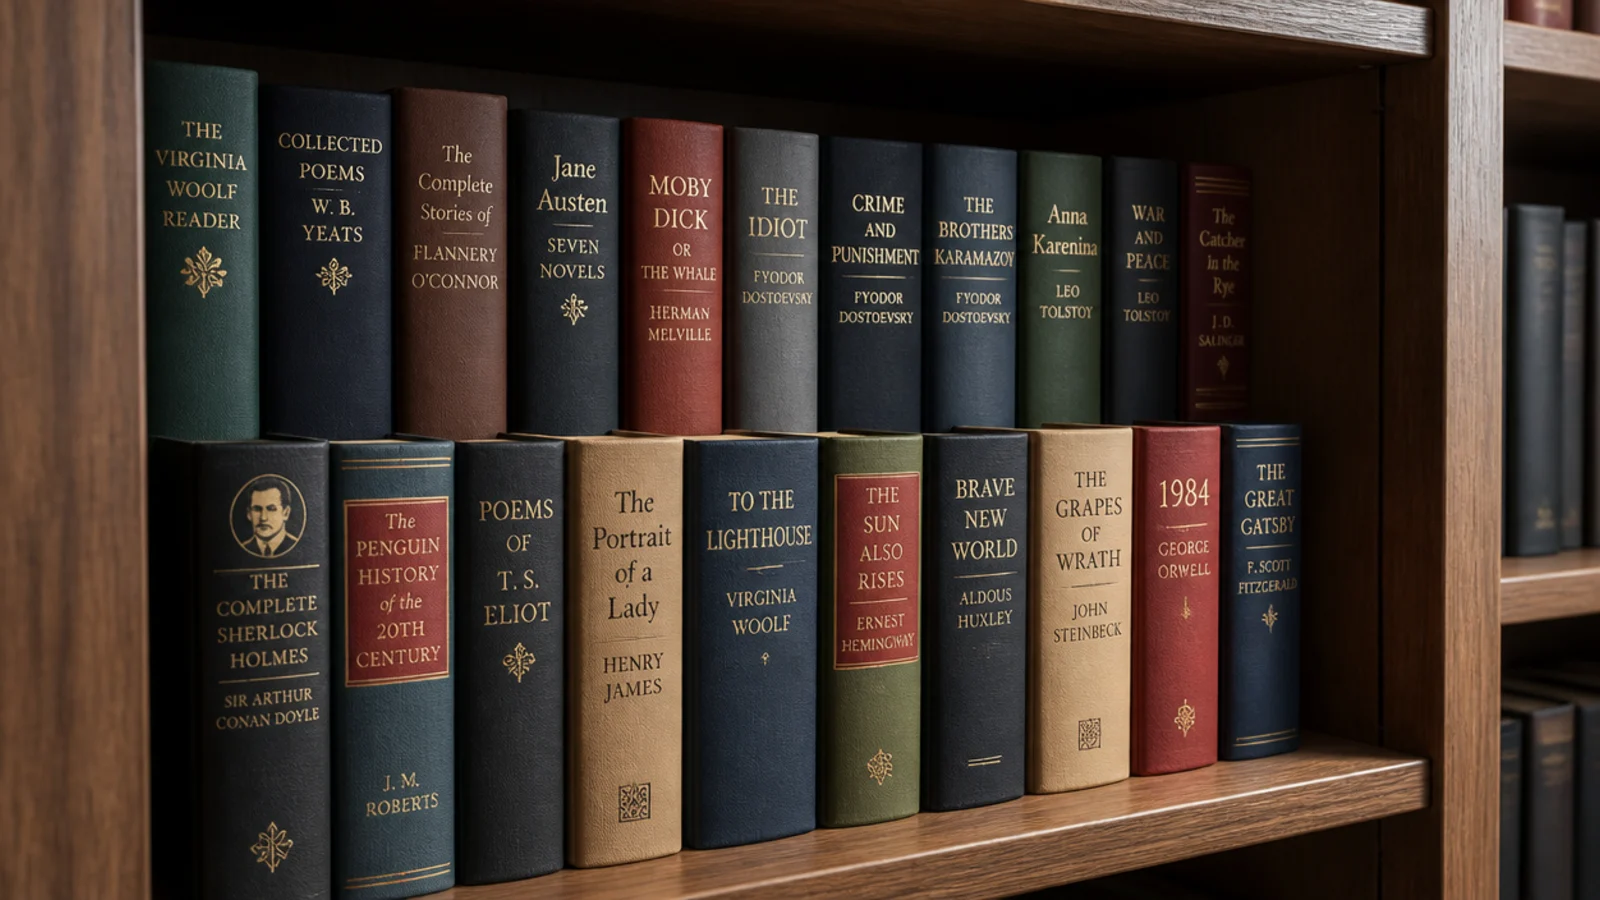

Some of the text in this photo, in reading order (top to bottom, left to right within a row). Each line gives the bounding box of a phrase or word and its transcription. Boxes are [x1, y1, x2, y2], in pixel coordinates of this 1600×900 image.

[180, 121, 222, 140] THE
[278, 132, 383, 154] COLLECTED
[155, 150, 247, 171] VIRGINIA
[442, 145, 472, 164] The
[299, 163, 365, 182] POEMS
[552, 155, 596, 182] Jane
[166, 180, 238, 199] WOOLF
[418, 173, 493, 197] Complete
[649, 174, 712, 198] MOBY
[537, 189, 608, 213] Austen
[761, 187, 799, 206] THE
[852, 194, 905, 214] CRIME
[964, 196, 994, 214] THE
[312, 199, 355, 216] W. B.
[420, 203, 493, 227] Stories of
[1047, 204, 1088, 226] Anna
[1132, 204, 1166, 222] WAR
[1213, 207, 1235, 226] The
[163, 210, 241, 230] READER
[653, 208, 708, 230] DICK
[748, 216, 808, 240] IDIOT
[302, 225, 363, 243] YEATS
[865, 222, 896, 238] AND
[939, 221, 1014, 241] BROTHERS
[1134, 230, 1163, 244] AND
[1199, 230, 1246, 248] Catcher
[413, 244, 498, 263] FLANNERY
[547, 238, 599, 255] SEVEN
[673, 242, 691, 258] OR
[1032, 234, 1098, 257] Karenina
[832, 246, 919, 266] PUNISHMENT
[1126, 252, 1170, 270] PEACE
[1207, 255, 1240, 271] in the
[540, 263, 605, 280] NOVELS
[641, 265, 717, 282] THE WHALE
[412, 273, 499, 290] O'CONNOR
[1056, 284, 1080, 298] LEO
[1213, 276, 1235, 298] Rye
[1137, 292, 1160, 304] LEO
[649, 305, 710, 321] HERMAN
[1040, 305, 1093, 319] TOLSTOY
[1123, 308, 1171, 322] TOLSTOY
[648, 327, 711, 342] MELVILLE
[1074, 471, 1107, 488] THE
[1257, 463, 1286, 481] THE
[866, 487, 899, 504] THE
[956, 477, 1015, 499] BRAVE
[1159, 478, 1210, 508] 1984
[615, 490, 654, 514] The
[728, 489, 794, 512] TO THE
[1056, 497, 1122, 518] GRAPES
[1244, 489, 1295, 508] GREAT
[479, 499, 554, 521] POEMS
[964, 508, 1007, 528] NEW
[385, 513, 416, 530] The
[864, 515, 900, 533] SUN
[1240, 516, 1295, 535] GATSBY
[506, 534, 531, 552] OF
[593, 524, 672, 550] Portrait
[706, 525, 812, 550] LIGHTHOUSE
[1081, 526, 1101, 542] OF
[356, 537, 440, 558] PENGUIN
[859, 543, 903, 562] ALSO
[952, 538, 1018, 560] WORLD
[1056, 549, 1121, 570] WRATH
[357, 565, 440, 585] HISTORY
[497, 569, 539, 591] T. S.
[615, 560, 652, 588] of a
[858, 571, 904, 590] RISES
[1158, 563, 1211, 579] ORWELL
[249, 572, 288, 590] THE
[216, 595, 318, 617] COMPLETE
[380, 592, 423, 615] of the
[726, 588, 797, 607] VIRGINIA
[959, 588, 1012, 605] ALDOUS
[484, 601, 551, 626] ELIOT
[608, 593, 660, 623] Lady
[1072, 602, 1108, 620] JOHN
[731, 614, 791, 635] WOOLF
[857, 613, 905, 631] ERNEST
[957, 610, 1013, 628] HUXLEY
[217, 621, 319, 643] SHERLOCK
[377, 621, 425, 640] 20TH
[1053, 622, 1122, 643] STEINBECK
[230, 648, 309, 669] HOLMES
[356, 645, 441, 669] CENTURY
[604, 652, 664, 673] HENRY
[224, 687, 313, 708] SIR ARTHUR
[604, 678, 662, 704] JAMES
[216, 707, 319, 730] CONAN DOYLE
[383, 772, 419, 792] J. M.
[366, 793, 439, 817] ROBERTS
